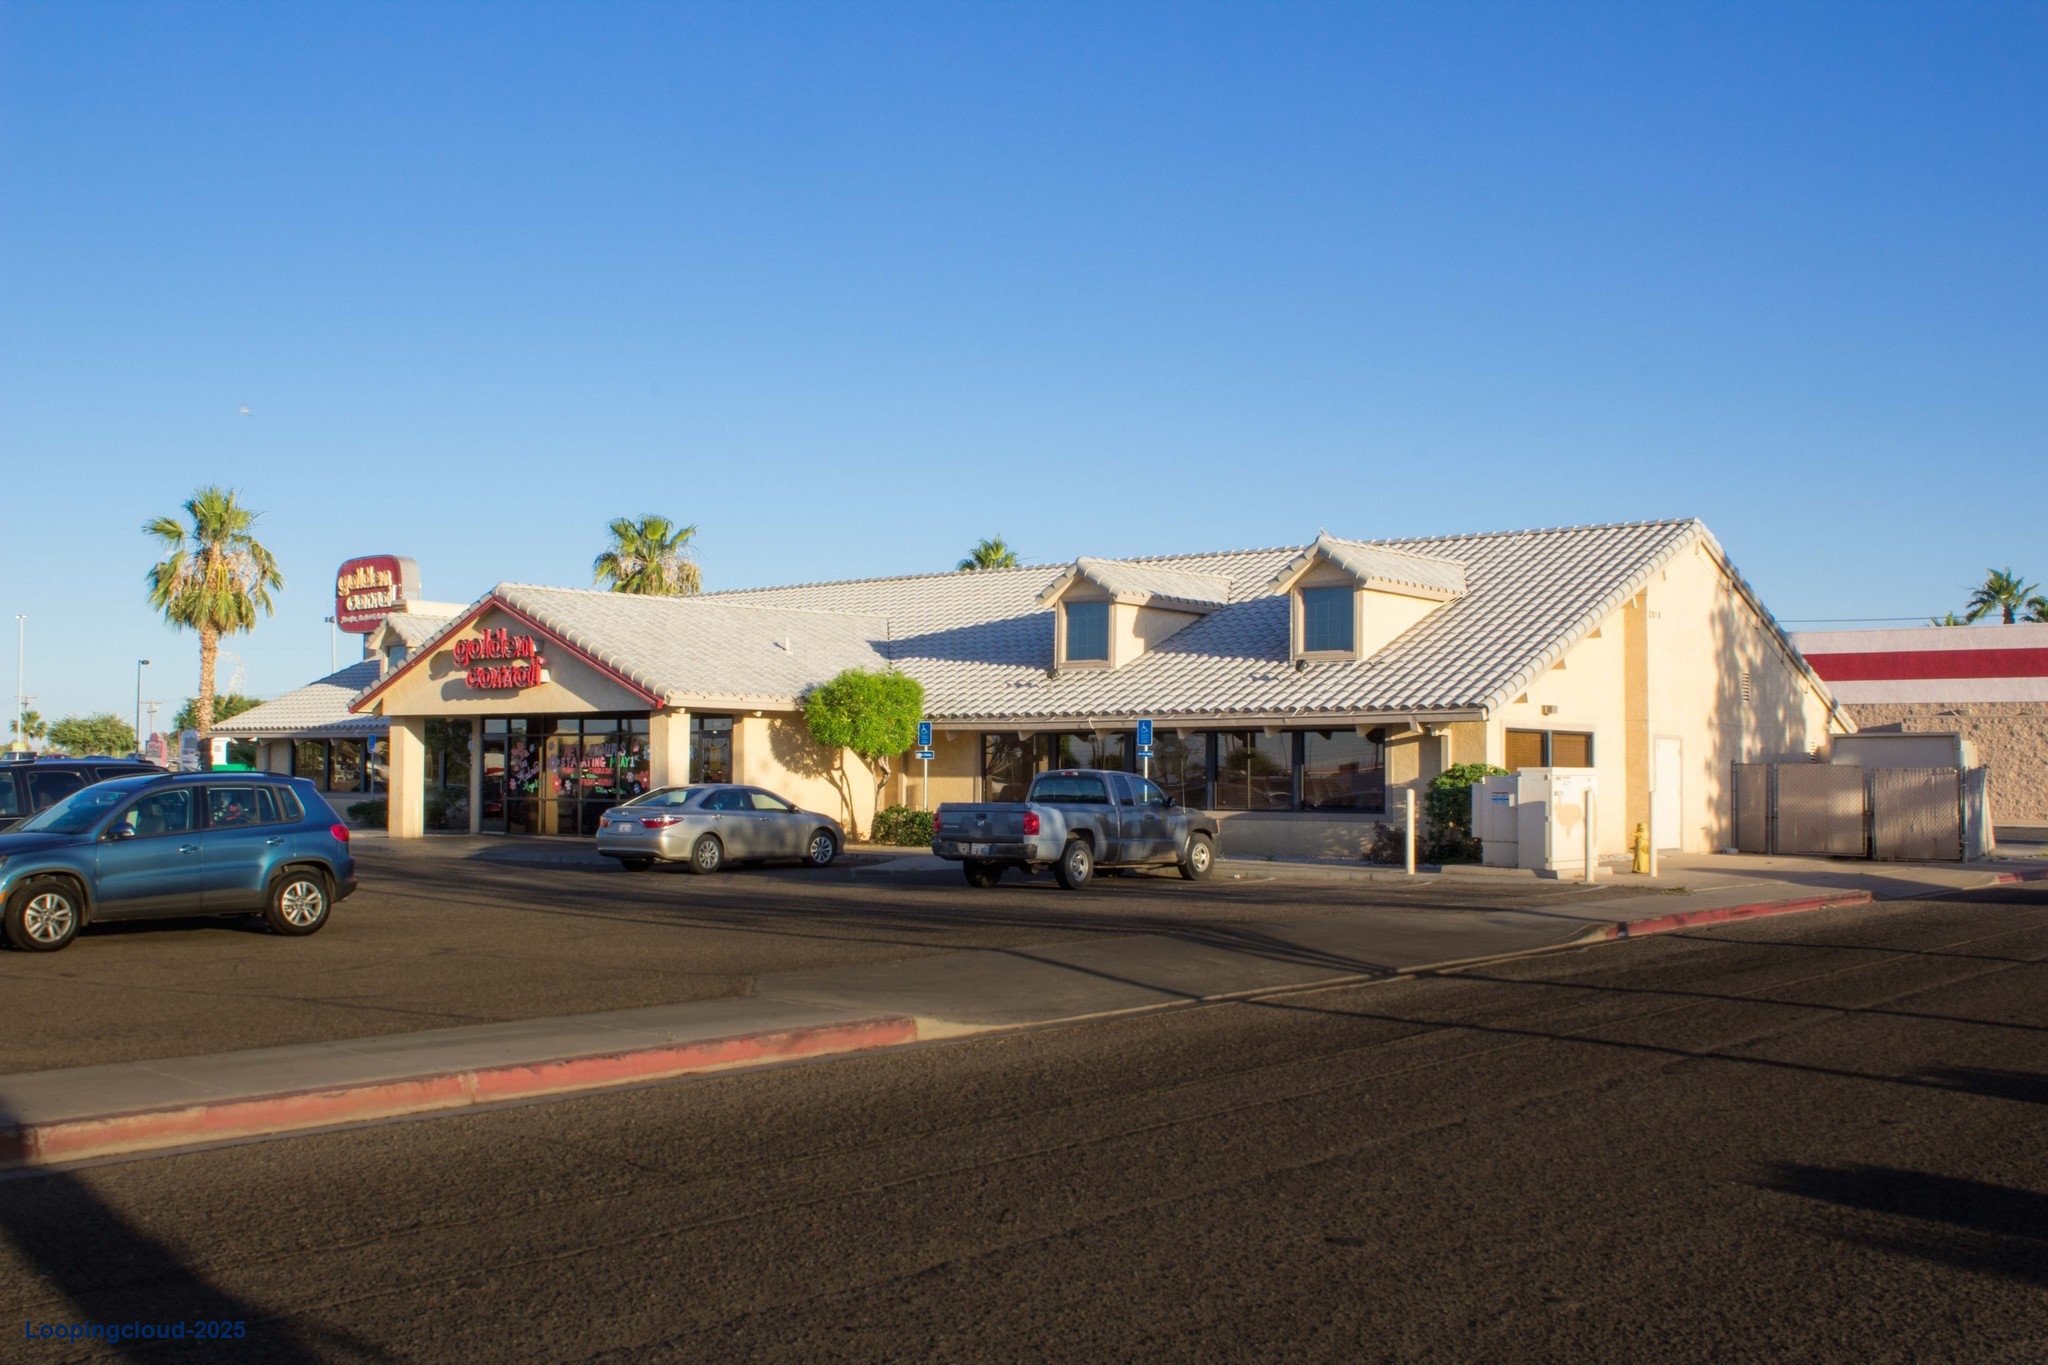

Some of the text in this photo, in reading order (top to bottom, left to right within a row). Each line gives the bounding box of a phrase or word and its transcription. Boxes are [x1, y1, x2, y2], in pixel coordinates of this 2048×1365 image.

[338, 566, 392, 596] golden
[346, 584, 397, 611] corral
[453, 627, 535, 668] golden
[465, 656, 542, 689] corral
